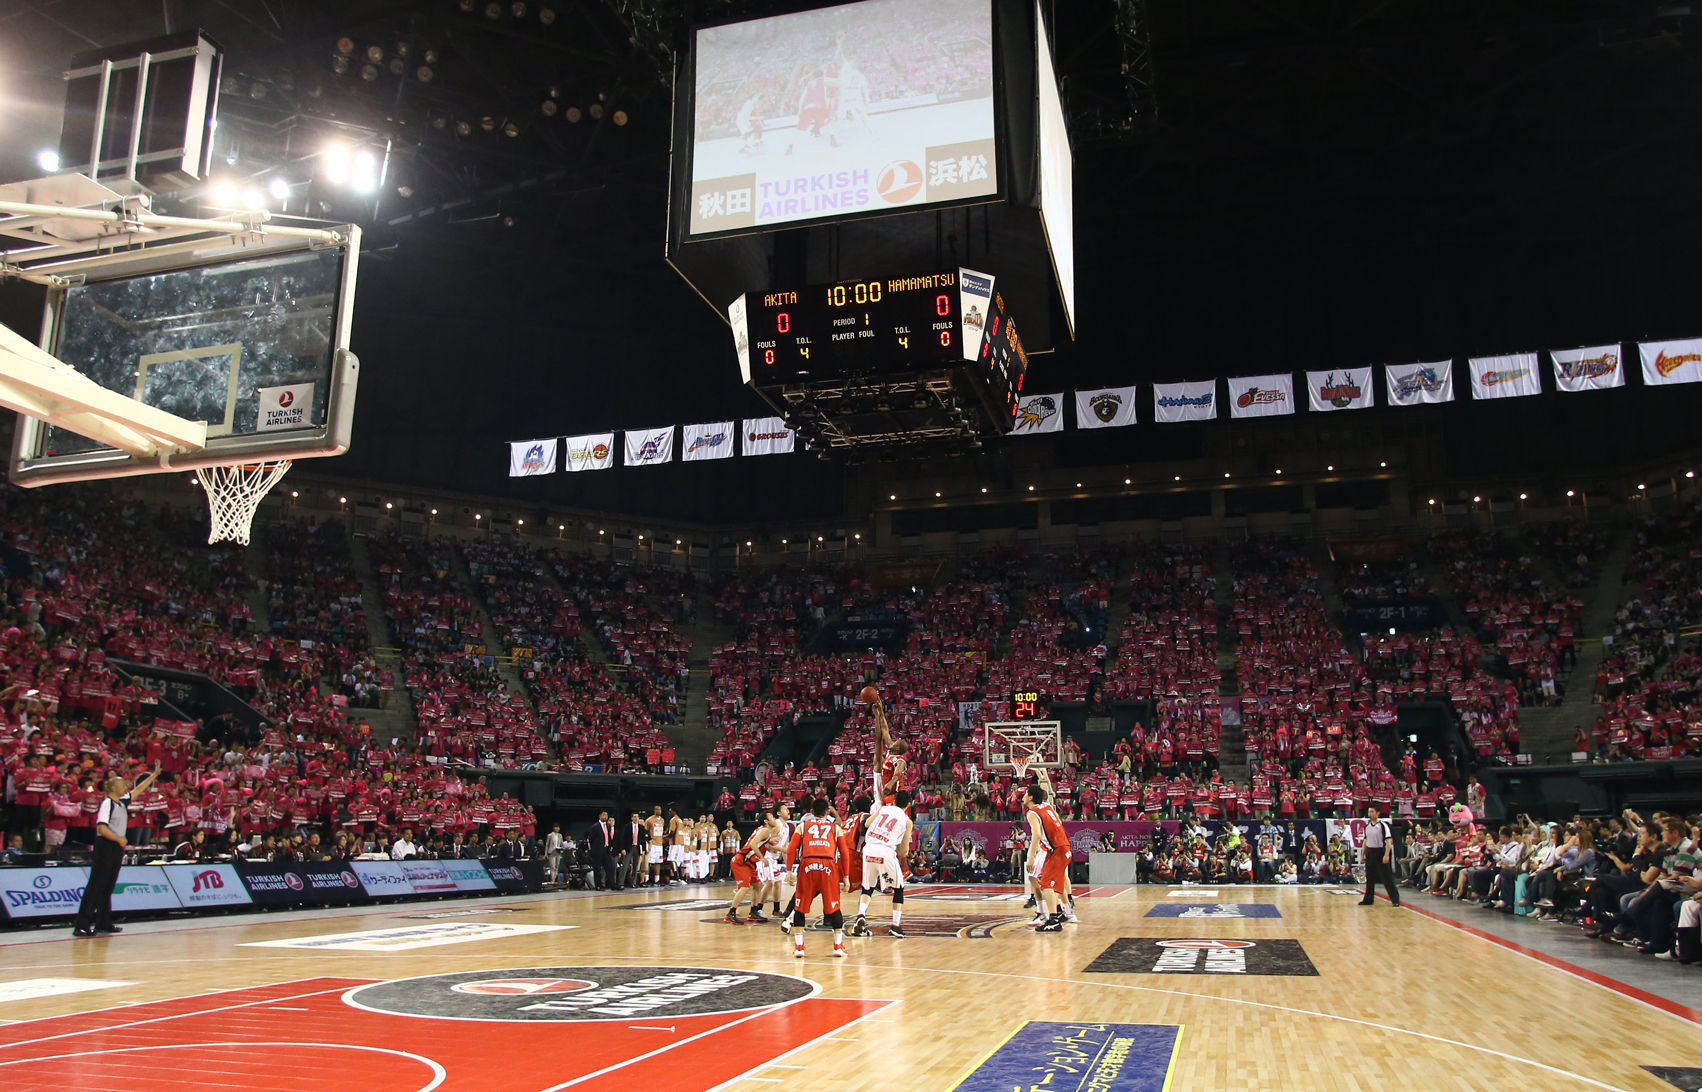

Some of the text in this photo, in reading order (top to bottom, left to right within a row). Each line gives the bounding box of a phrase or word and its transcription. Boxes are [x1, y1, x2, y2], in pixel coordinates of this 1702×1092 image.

[929, 154, 988, 187] 浜松
[759, 168, 869, 199] TURKISH
[699, 188, 751, 219] 秋田
[758, 188, 870, 219] AIRLINES
[888, 273, 955, 292] HAMAMATSU
[764, 291, 797, 307] AKITA
[827, 282, 881, 306] 10:00
[936, 295, 950, 316] 0
[777, 313, 790, 333] 0
[833, 313, 869, 327] PERIOD 1
[932, 321, 953, 330] FOULS
[796, 337, 812, 345] T.O.L.
[832, 330, 875, 341] PLAYER FOUL
[940, 331, 950, 346] 0
[757, 340, 776, 349] FOULS
[899, 337, 908, 349] 4
[765, 350, 774, 364] 0
[800, 347, 809, 359] 4
[267, 408, 303, 418] TURKISH
[266, 416, 302, 426] AIRLINES
[1380, 607, 1405, 619] 2F-1
[856, 629, 878, 640] 2F-2
[1015, 692, 1038, 702] 10:00
[1015, 702, 1034, 718] 24
[878, 814, 898, 832] 14
[808, 824, 832, 840] 47
[192, 870, 224, 893] JTB
[246, 874, 284, 883] TURKISH
[307, 873, 341, 881] TURKISH
[312, 880, 345, 888] AIRLINES
[251, 882, 288, 890] AIRLINES
[516, 973, 711, 1011] TURKISH
[588, 974, 760, 1016] AIRLINES
